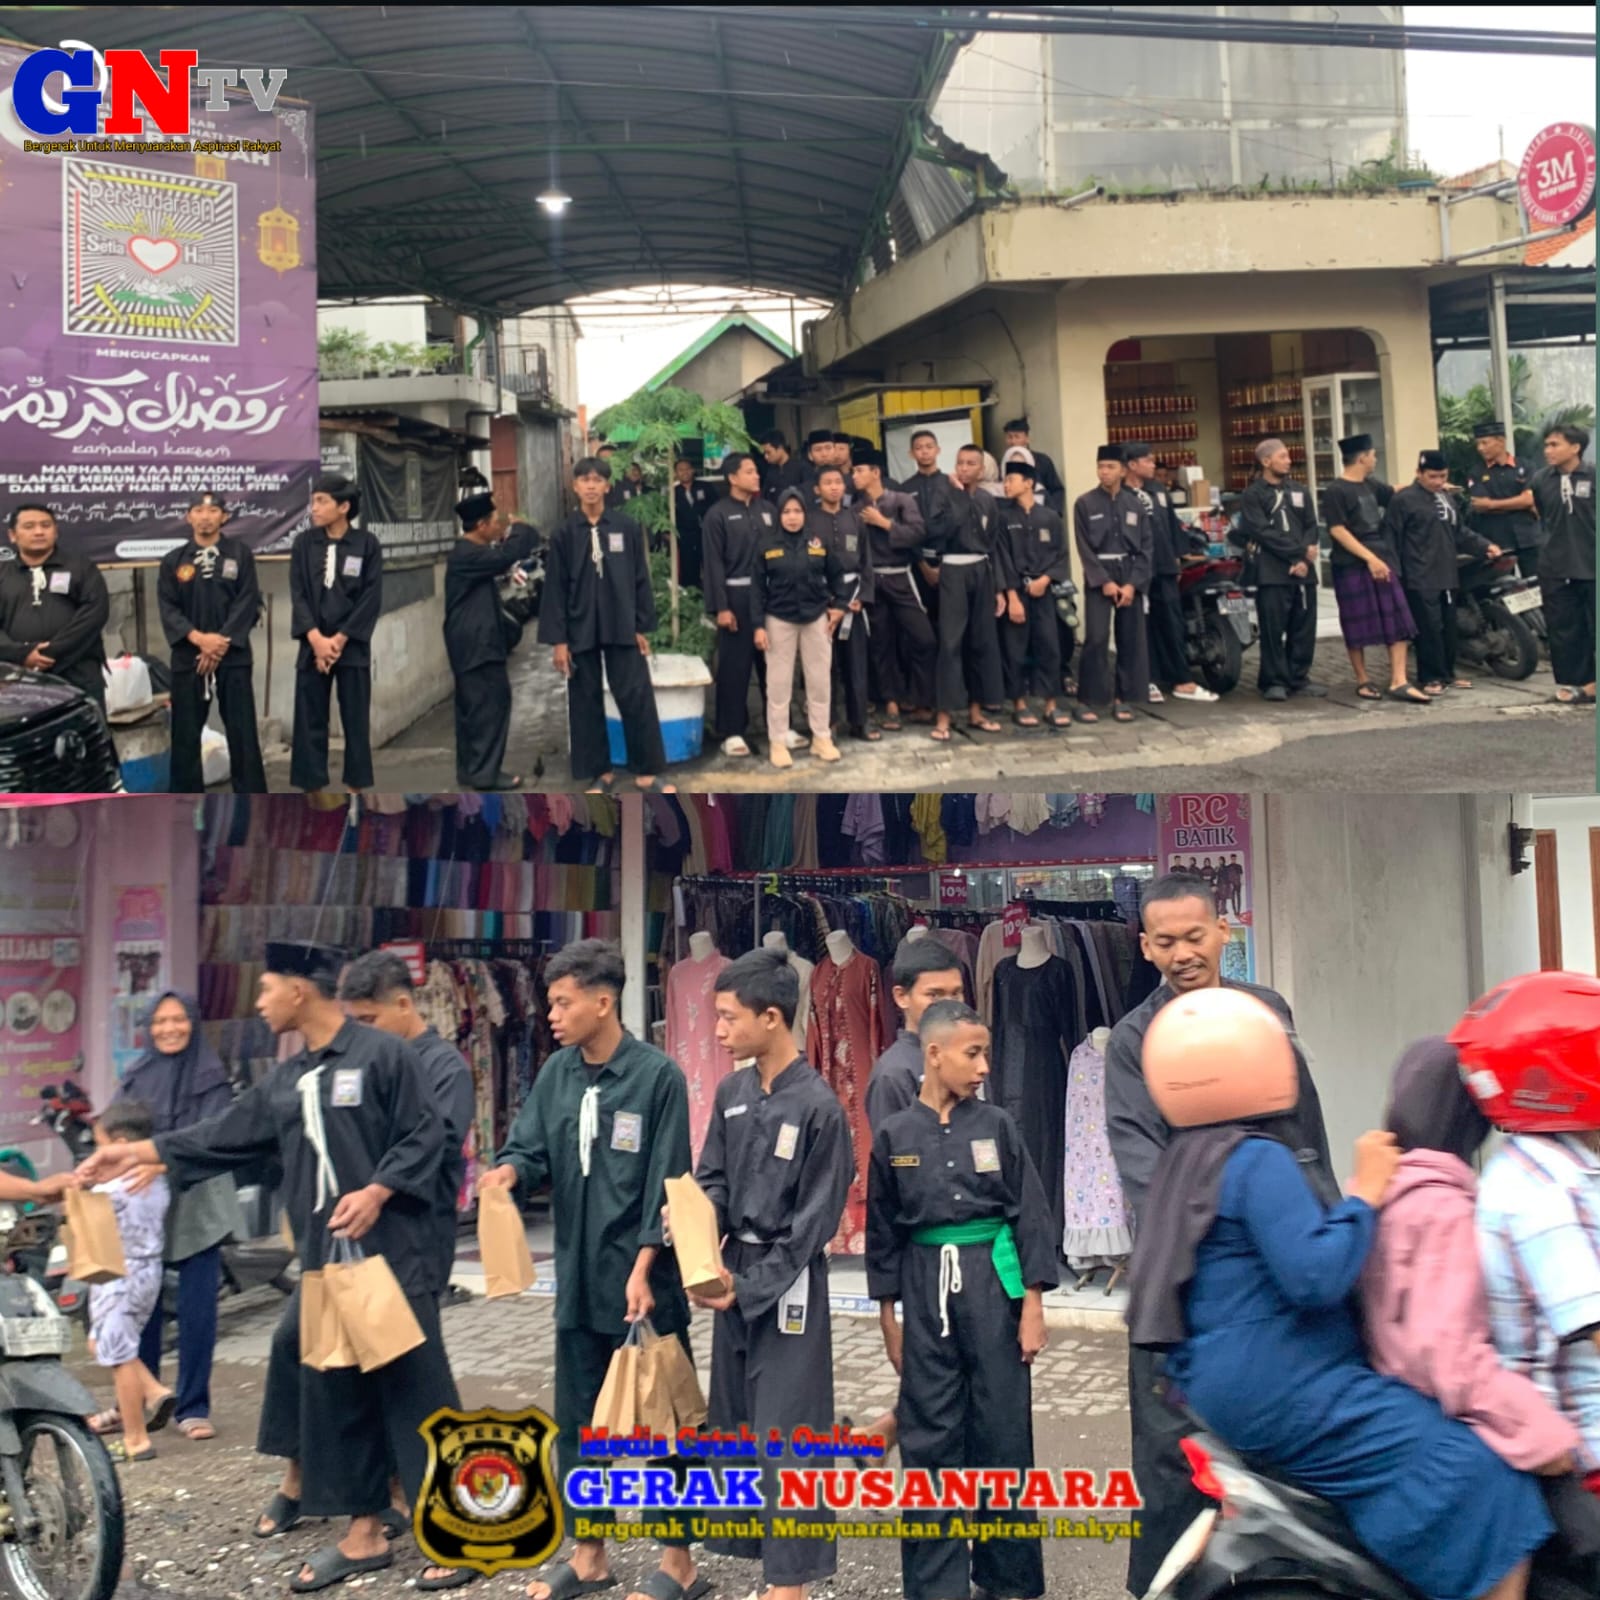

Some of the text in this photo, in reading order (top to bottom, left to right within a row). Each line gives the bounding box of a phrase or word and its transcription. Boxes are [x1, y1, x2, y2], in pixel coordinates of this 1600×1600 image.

[1536, 150, 1577, 189] 3M
[88, 181, 216, 223] Persaudaraan
[85, 234, 215, 264] Setia Hati
[127, 312, 181, 329] TERATE
[96, 348, 210, 363] MENGUCAPKAN
[164, 441, 231, 458] kareem
[41, 464, 256, 475] MARHABAN YAA RAMADHAN
[0, 474, 289, 484] SELAMAT MENUNAIKAN IBADAH PUASA
[9, 483, 281, 494] DAN SELAMAT HARI RAYA IDUL FITRI
[1179, 793, 1229, 827] RC
[1173, 826, 1238, 848] BATIK
[940, 886, 967, 897] 10%
